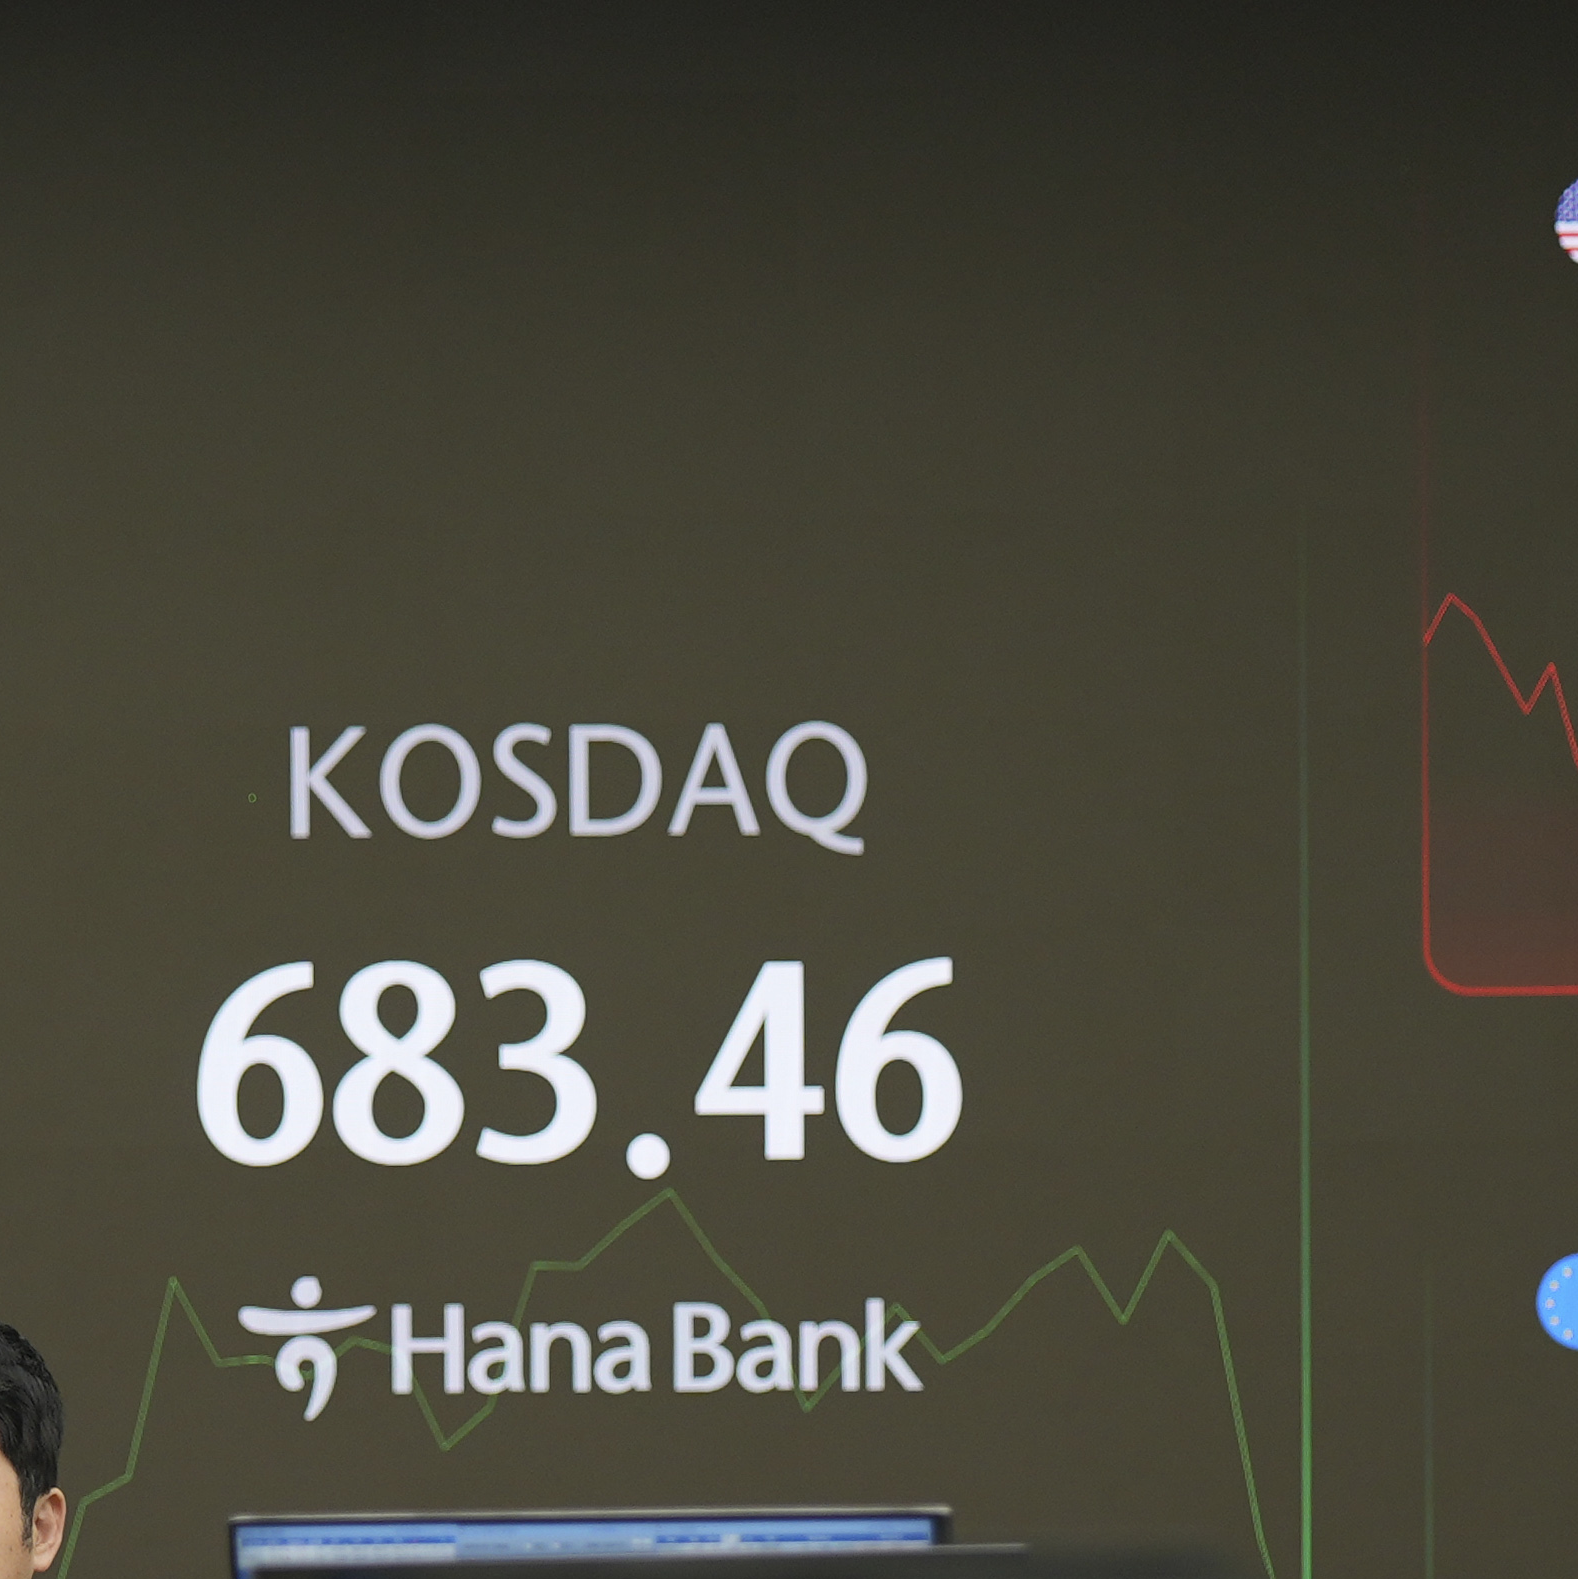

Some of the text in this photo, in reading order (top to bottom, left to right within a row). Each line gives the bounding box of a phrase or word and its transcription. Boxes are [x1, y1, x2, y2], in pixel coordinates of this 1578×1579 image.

[289, 720, 868, 856] KOSDAQ
[195, 956, 964, 1180] 683.46
[390, 1296, 924, 1400] Hana Bank
